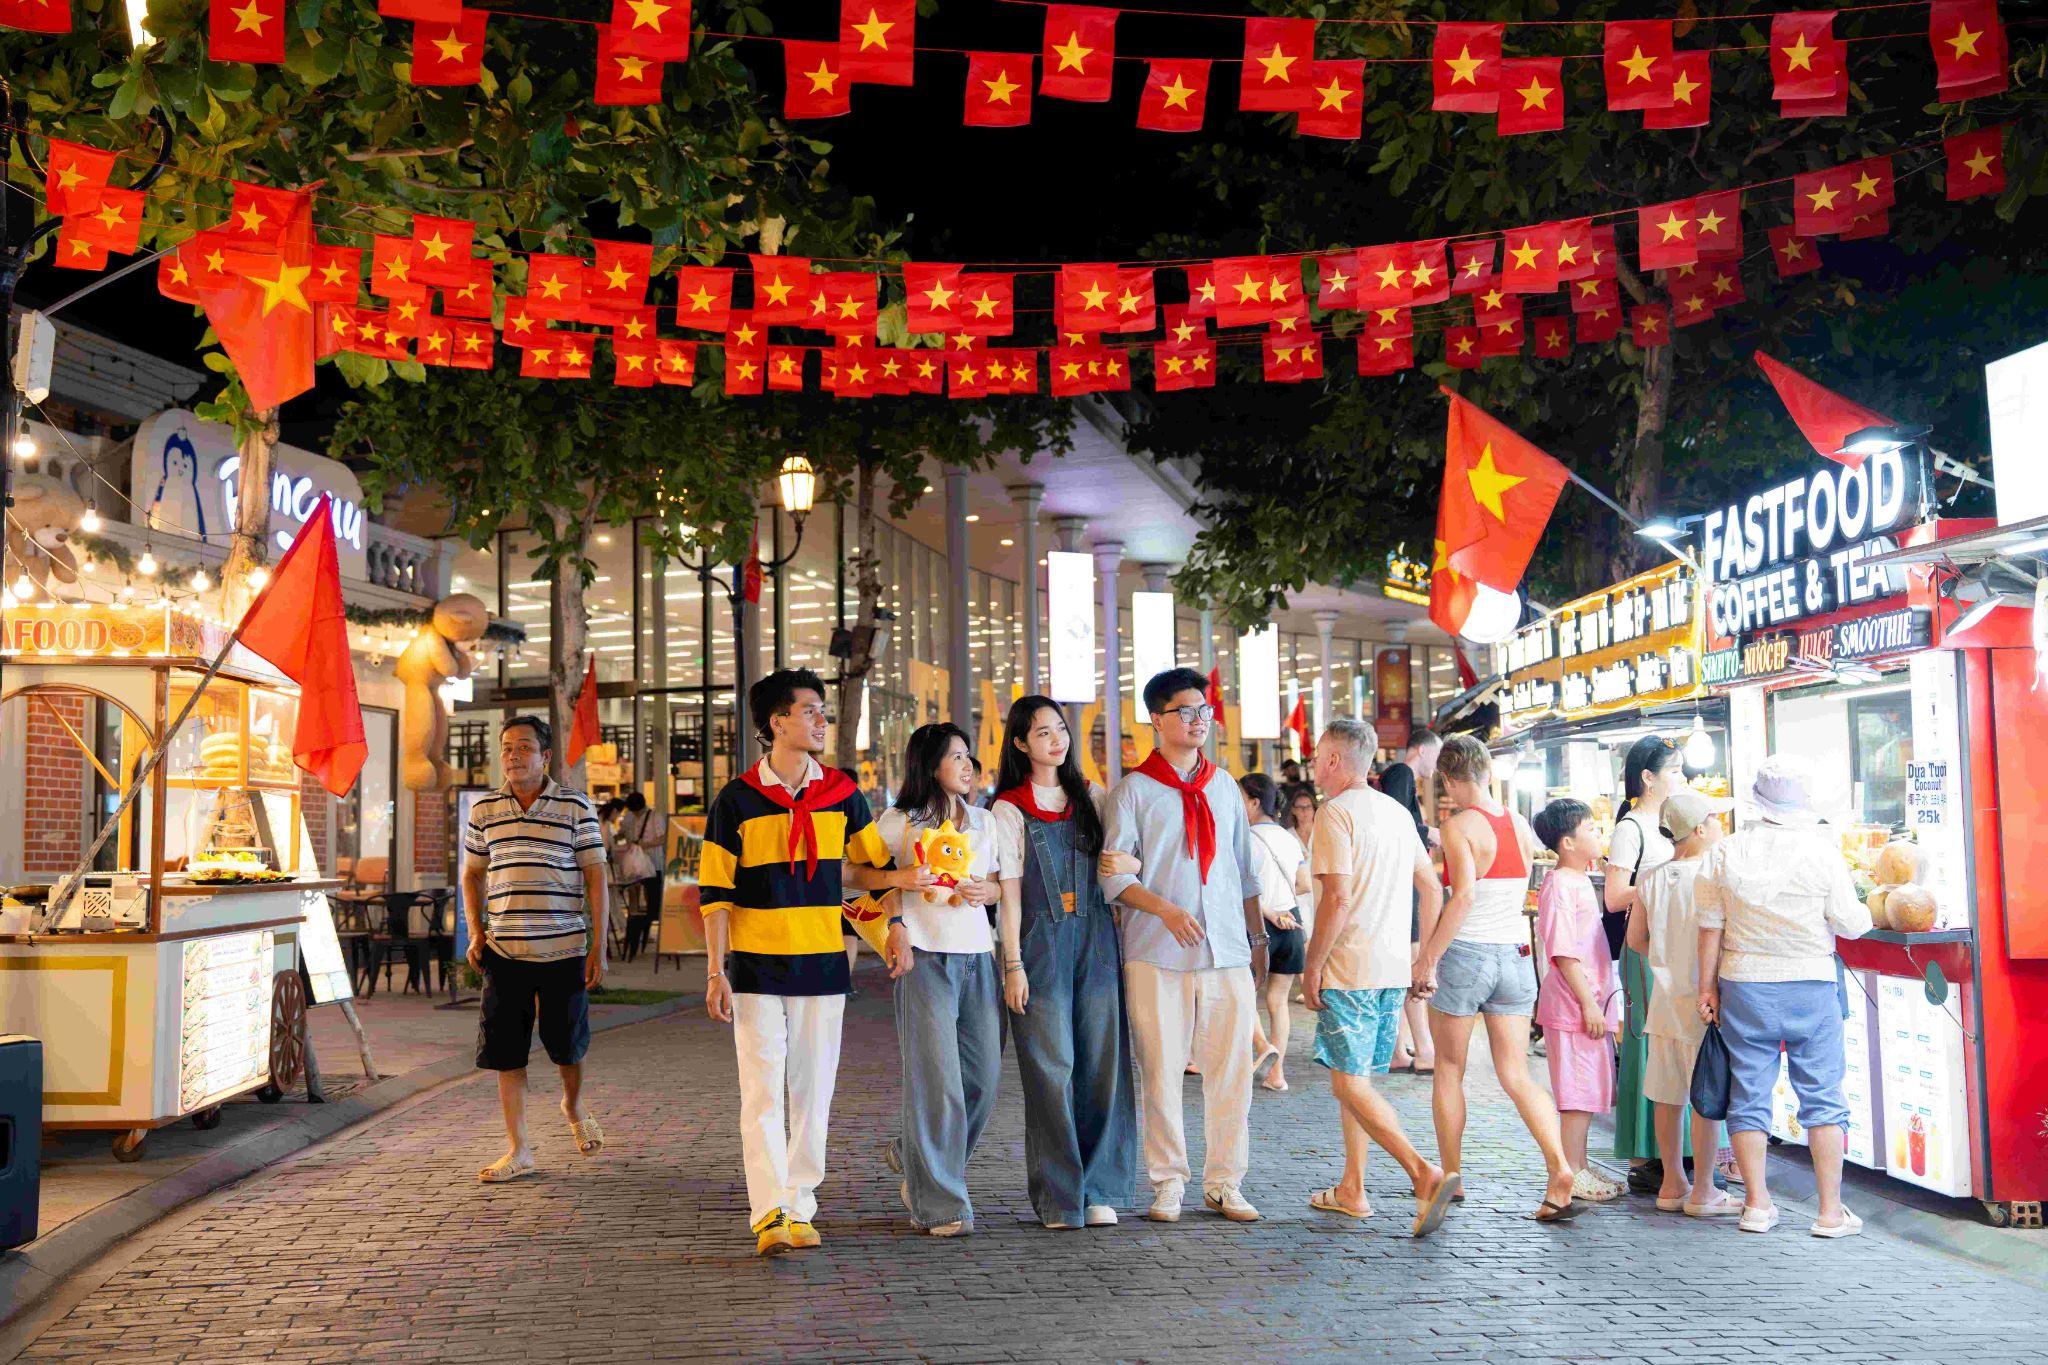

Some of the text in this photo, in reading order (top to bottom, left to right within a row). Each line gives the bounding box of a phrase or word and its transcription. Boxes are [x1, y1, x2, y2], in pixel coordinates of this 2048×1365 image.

[1705, 449, 1905, 583] FASTFOOD
[1711, 567, 1799, 636] COFFEE
[1805, 559, 1823, 611] &
[1831, 538, 1891, 603] TEA
[1917, 809, 1940, 824] 25k
